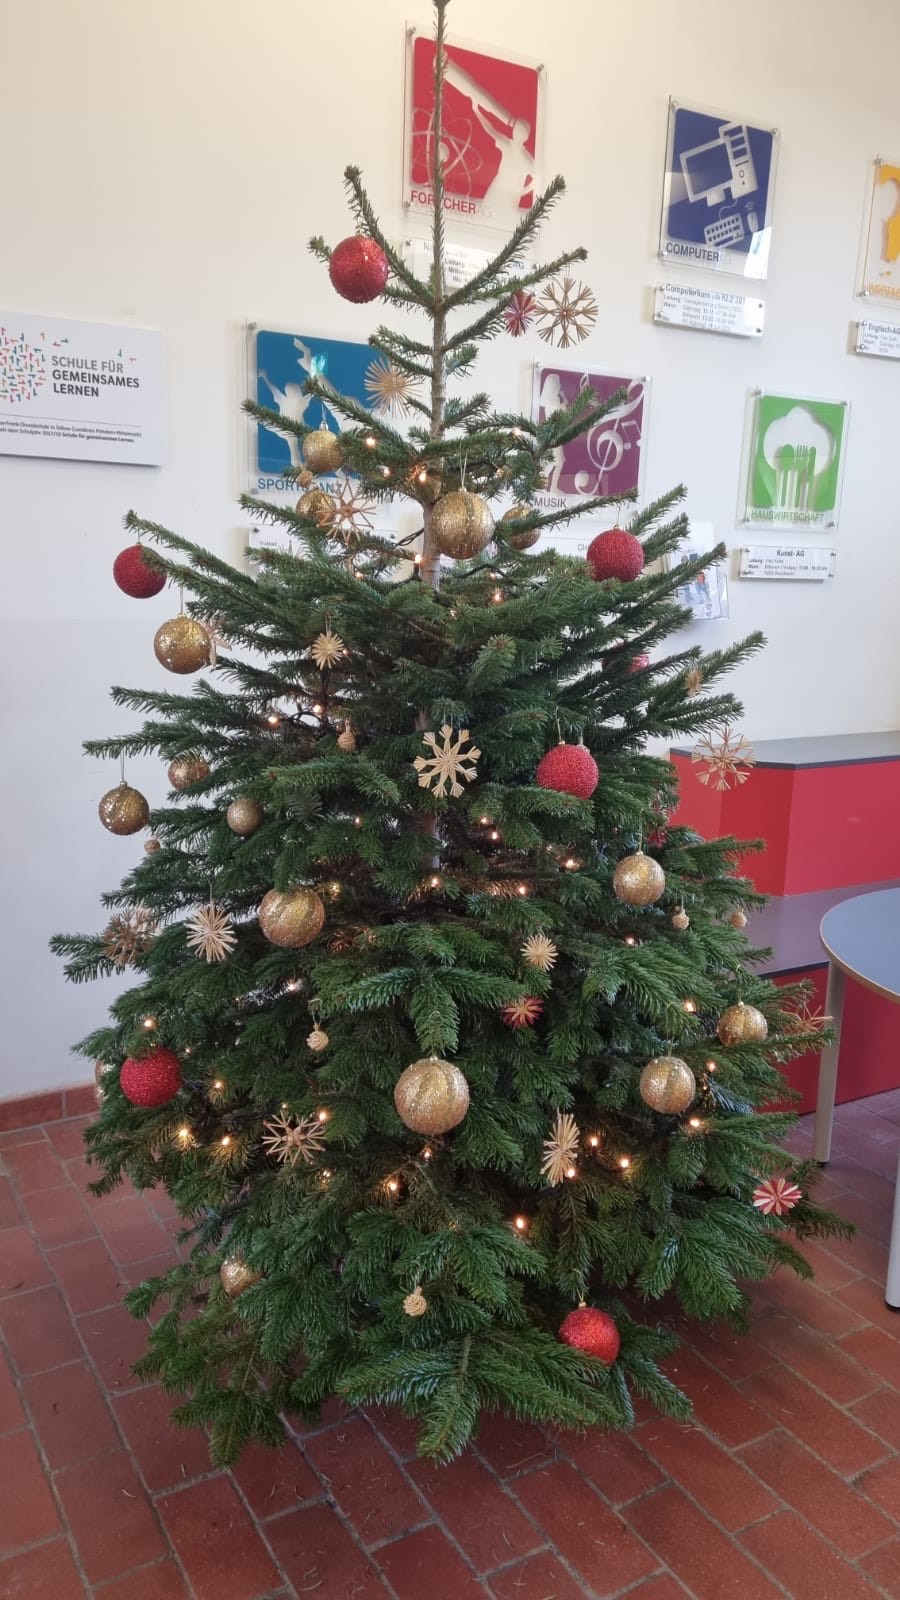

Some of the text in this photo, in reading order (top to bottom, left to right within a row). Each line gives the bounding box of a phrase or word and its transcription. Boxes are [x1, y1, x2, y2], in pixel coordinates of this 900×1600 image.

[410, 190, 476, 214] FORCHER
[665, 242, 720, 262] COMPUTER
[52, 355, 124, 373] SCHULE FÜR
[52, 369, 140, 388] GEMEINSAMES
[53, 382, 99, 397] LERNEN
[534, 497, 567, 508] MUSIK
[751, 509, 825, 523] HAUSWIRTSCHAFT
